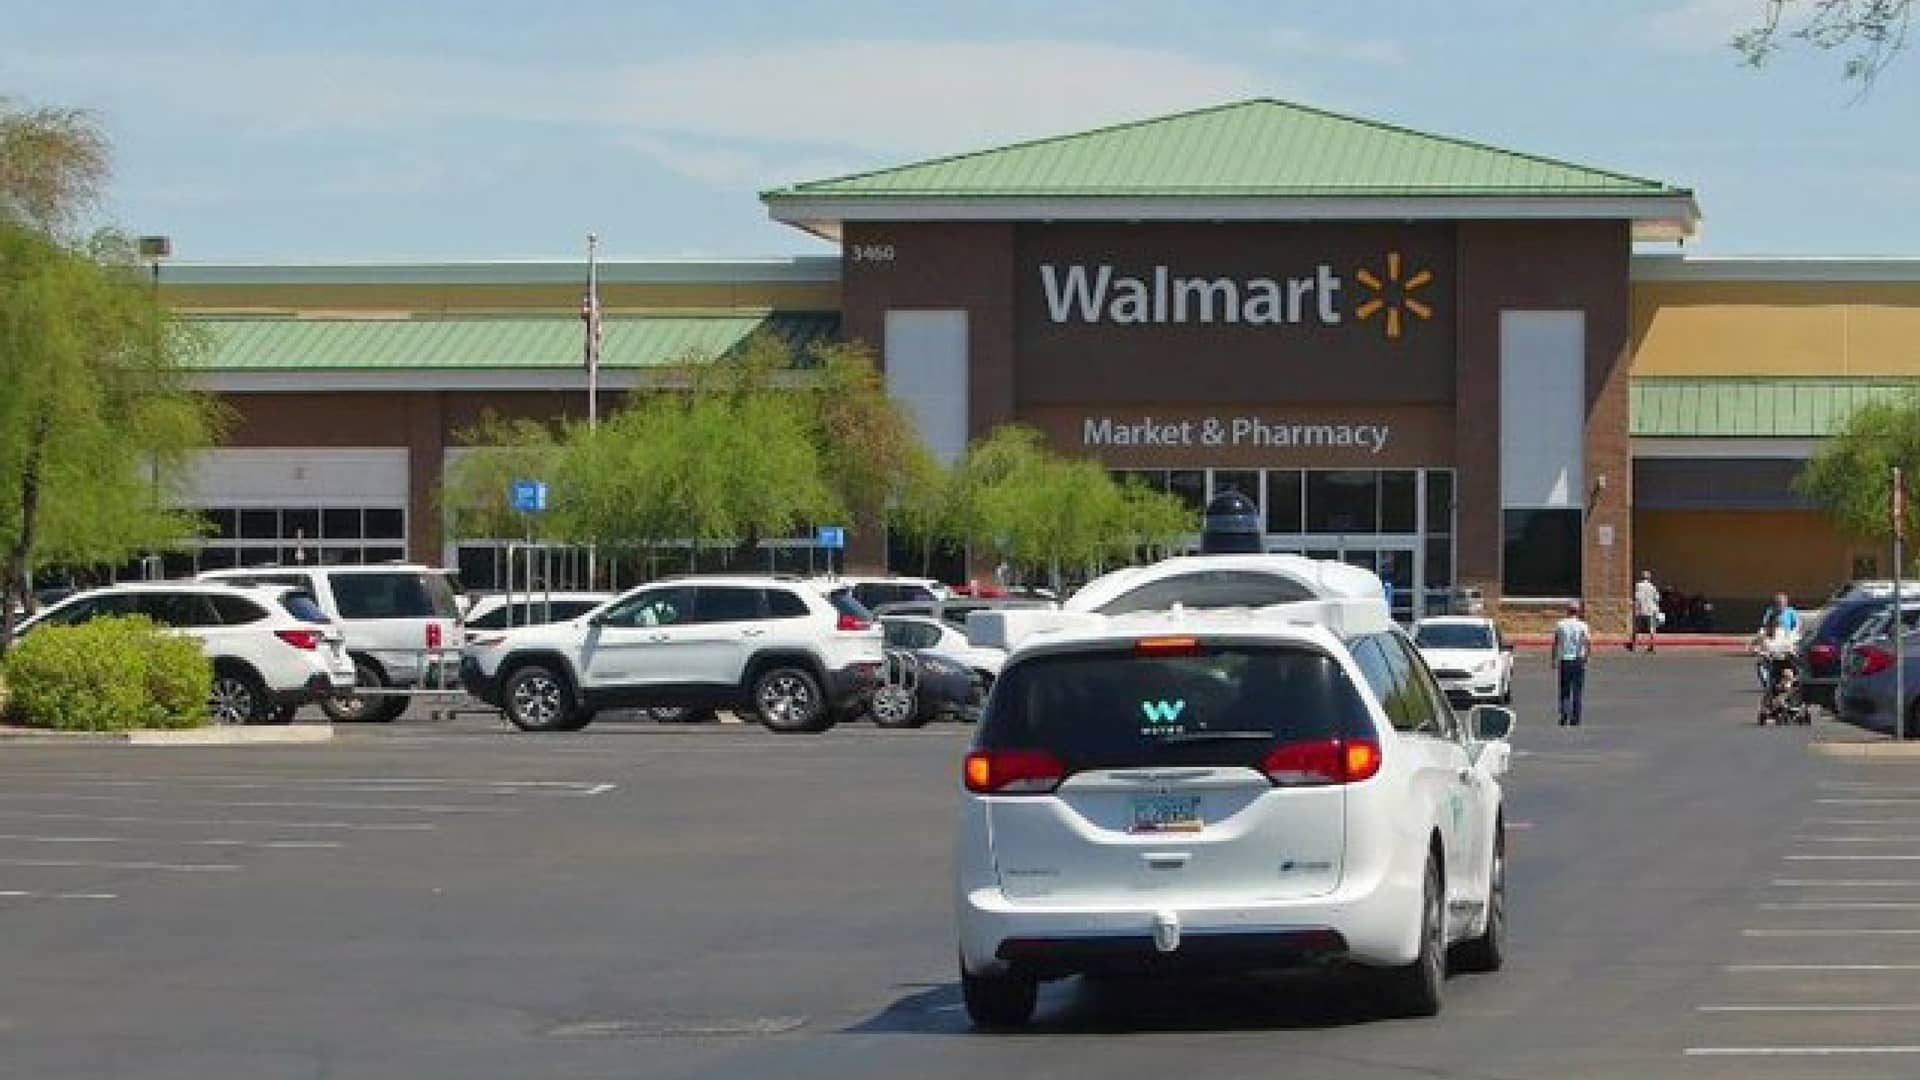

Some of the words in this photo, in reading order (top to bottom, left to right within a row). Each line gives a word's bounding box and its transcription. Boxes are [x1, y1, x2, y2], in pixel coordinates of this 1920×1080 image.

[852, 245, 894, 261] 3460
[1040, 265, 1341, 323] Walmart
[1083, 418, 1192, 446] Market
[1202, 418, 1226, 446] &
[1232, 418, 1389, 453] Pharmacy
